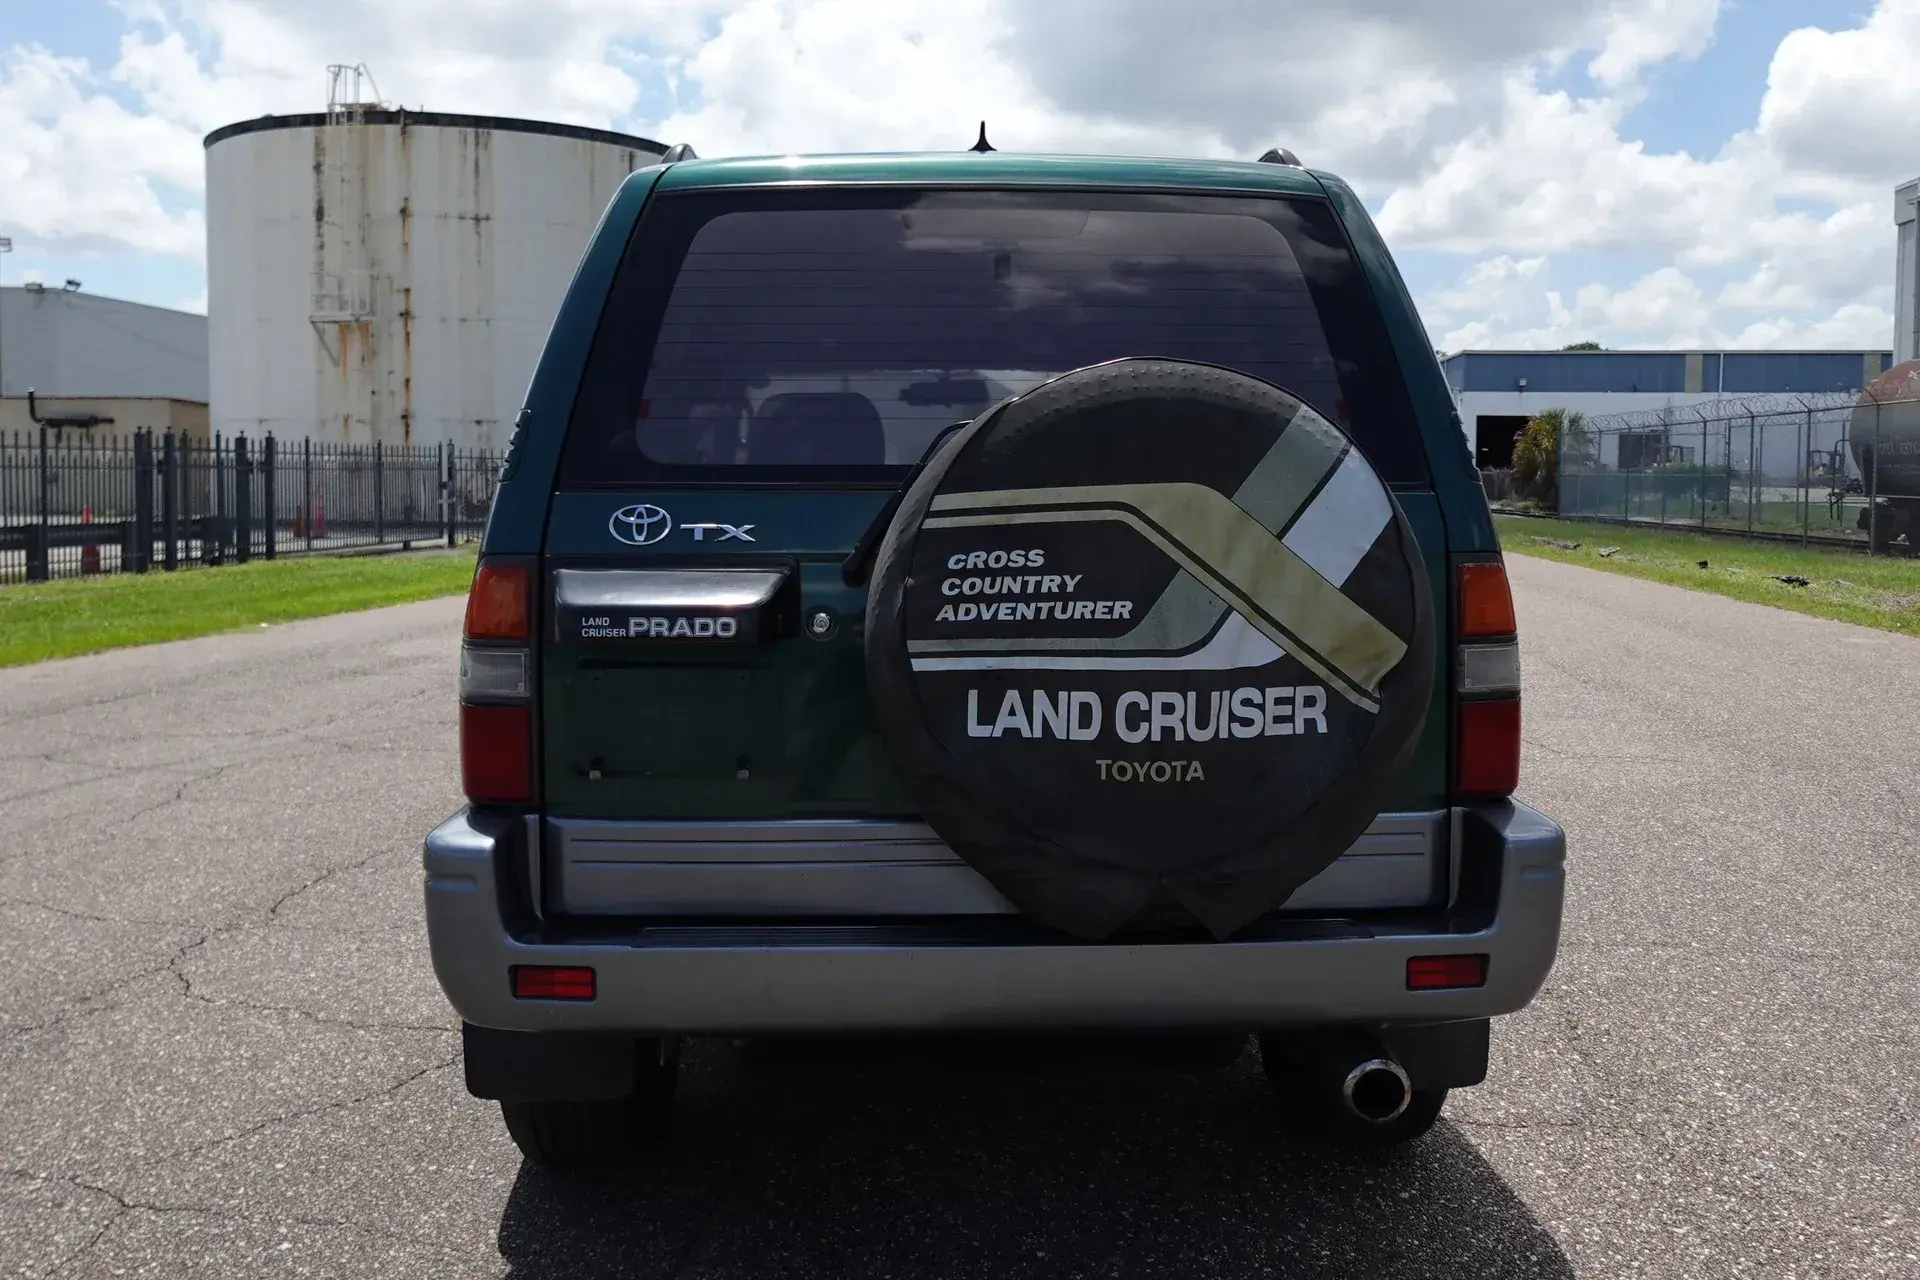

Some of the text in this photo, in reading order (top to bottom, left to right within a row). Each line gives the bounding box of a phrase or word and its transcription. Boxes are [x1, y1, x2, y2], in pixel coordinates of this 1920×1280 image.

[680, 524, 756, 542] TX
[947, 549, 1046, 570] CROSS
[941, 574, 1083, 597] COUNTRY
[581, 616, 610, 627] LAND
[935, 600, 1133, 623] ADVENTURER
[581, 627, 627, 638] CRUISER
[628, 616, 738, 639] PRADO
[967, 685, 1328, 744] LAND CRUISER
[1096, 759, 1205, 783] TOYOTA
